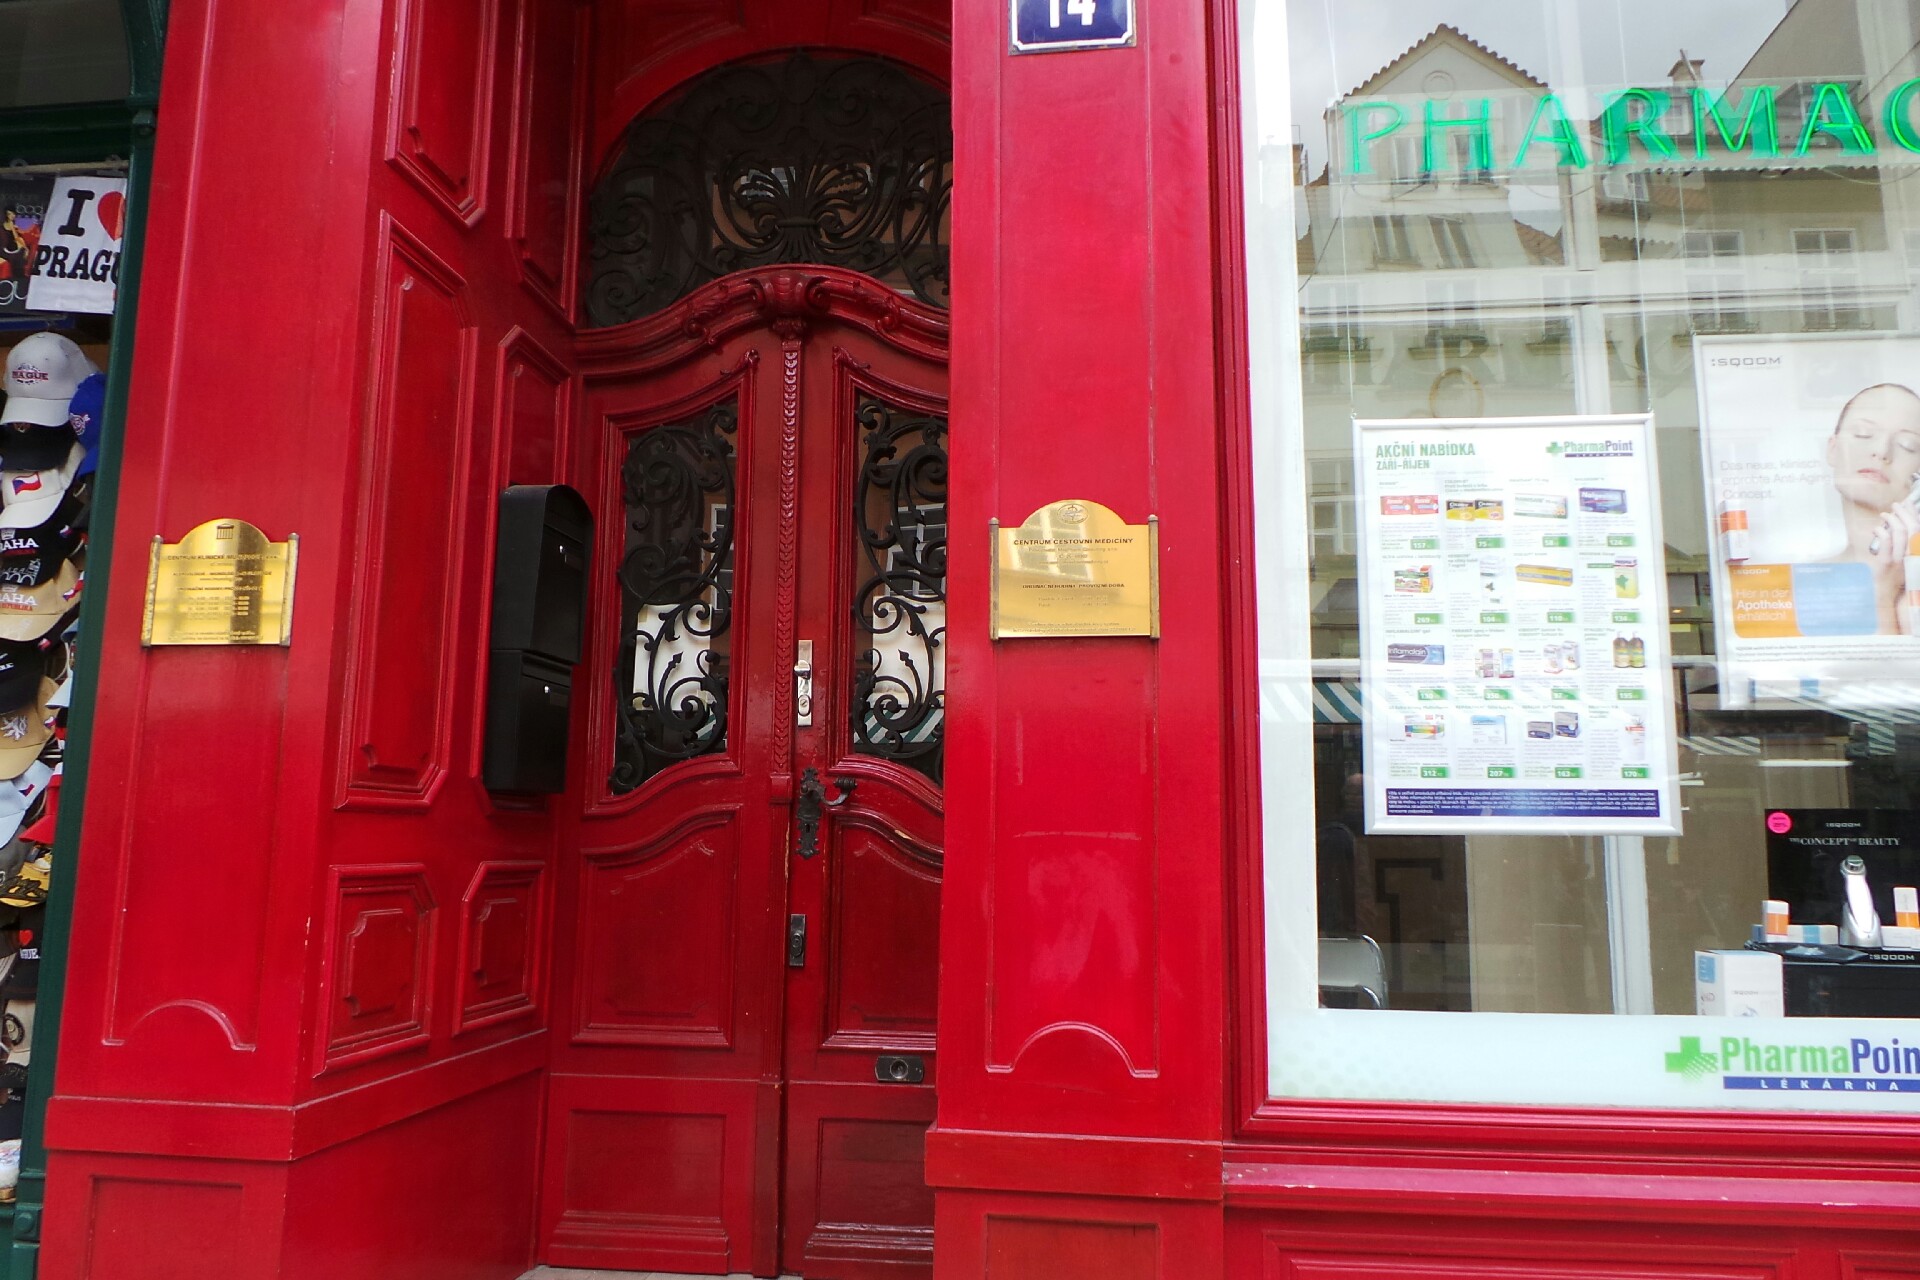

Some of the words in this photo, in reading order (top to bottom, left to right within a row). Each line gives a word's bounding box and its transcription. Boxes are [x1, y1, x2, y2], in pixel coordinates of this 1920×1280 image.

[57, 188, 95, 237] I
[1375, 441, 1415, 458] AKČNÍ
[1419, 440, 1476, 457] NABÍDKA
[1563, 440, 1634, 452] PharmaPoint
[1736, 600, 1793, 611] Apotheke
[1800, 837, 1849, 846] CONCEPT
[1858, 837, 1900, 846] BEAUTY
